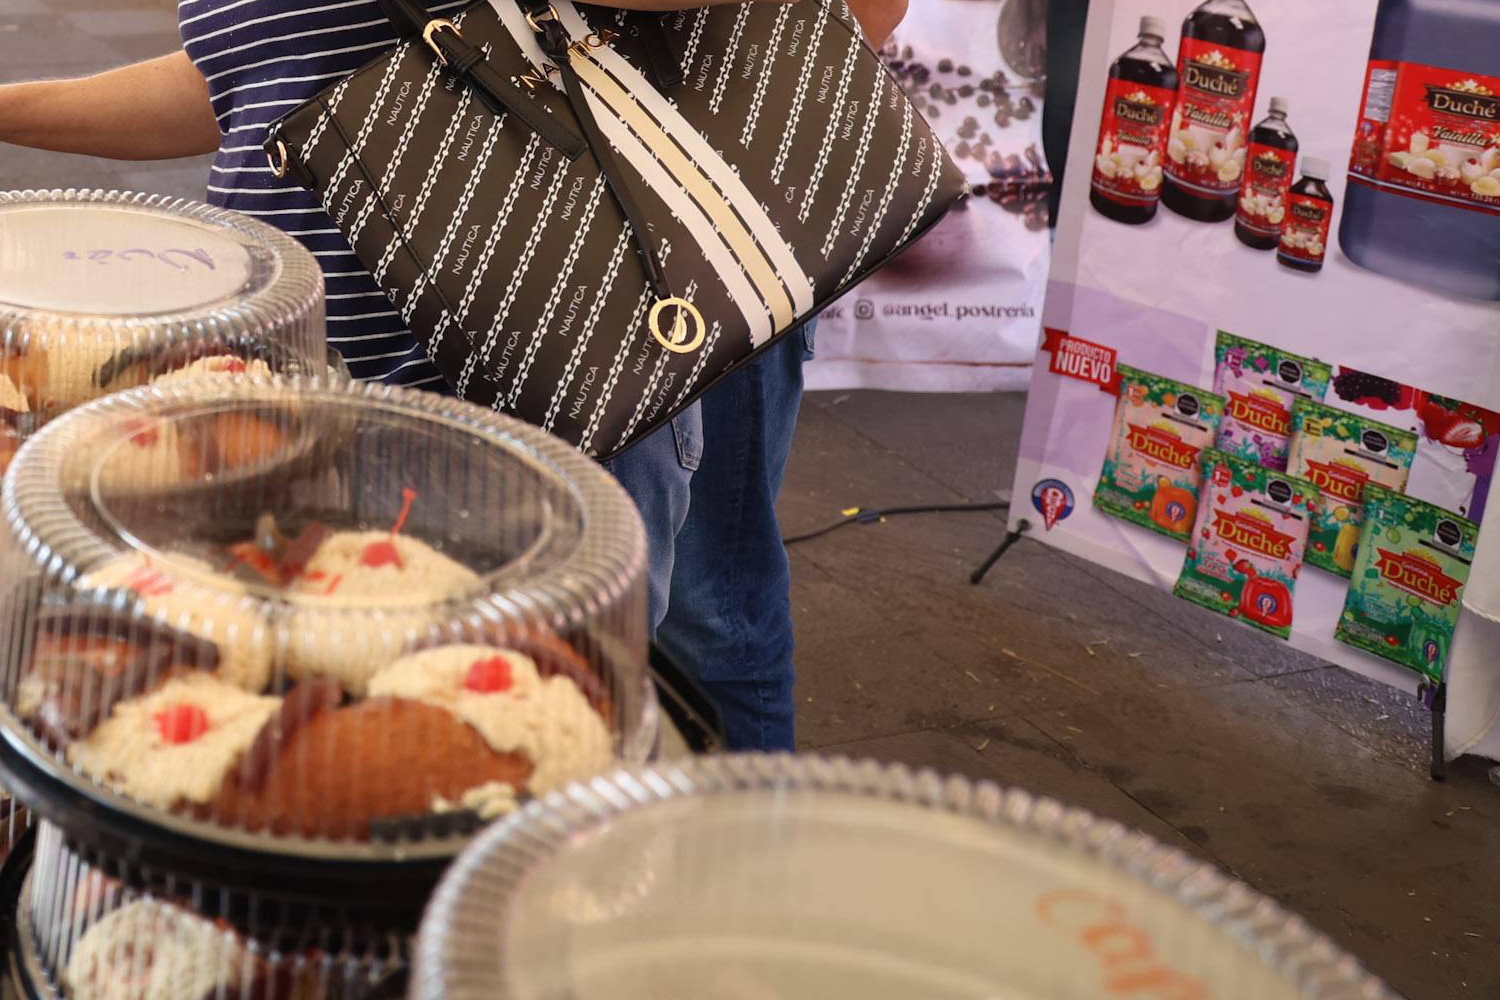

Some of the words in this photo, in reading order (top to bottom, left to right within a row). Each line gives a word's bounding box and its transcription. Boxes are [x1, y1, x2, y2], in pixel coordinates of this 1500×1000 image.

[788, 18, 807, 57] NAUTICA
[519, 27, 621, 91] NATICA
[694, 53, 714, 92] NAUTICA
[742, 43, 760, 81] NAUTICA
[816, 64, 835, 104] NAUTICA
[1185, 66, 1239, 96] Duché
[386, 80, 414, 126] NAUTICA
[841, 99, 860, 141] NAUTICA
[1115, 102, 1158, 123] Duché
[1183, 102, 1232, 128] Vainilla
[1433, 93, 1497, 119] Duché
[457, 113, 484, 162] NAUTICA
[1431, 124, 1489, 147] Vainilla
[530, 146, 555, 190] NAUTICA
[911, 136, 928, 178] NAUTICA
[335, 178, 365, 227] NAUTICA
[560, 175, 586, 222] NAUTICA
[850, 188, 876, 237] NAUTICA
[452, 223, 482, 276] NAUTICA
[558, 284, 589, 337] NAUTICA
[492, 329, 523, 383] NAUTICA
[1054, 350, 1113, 385] NUEVO
[1059, 337, 1113, 365] PRODUCTO
[568, 365, 600, 420] NAUTICA
[646, 370, 678, 423] NAUTICA
[1131, 431, 1193, 469] Duché
[1311, 468, 1362, 500] Duc
[1217, 518, 1286, 558] Duché
[1383, 557, 1451, 602] Duché
